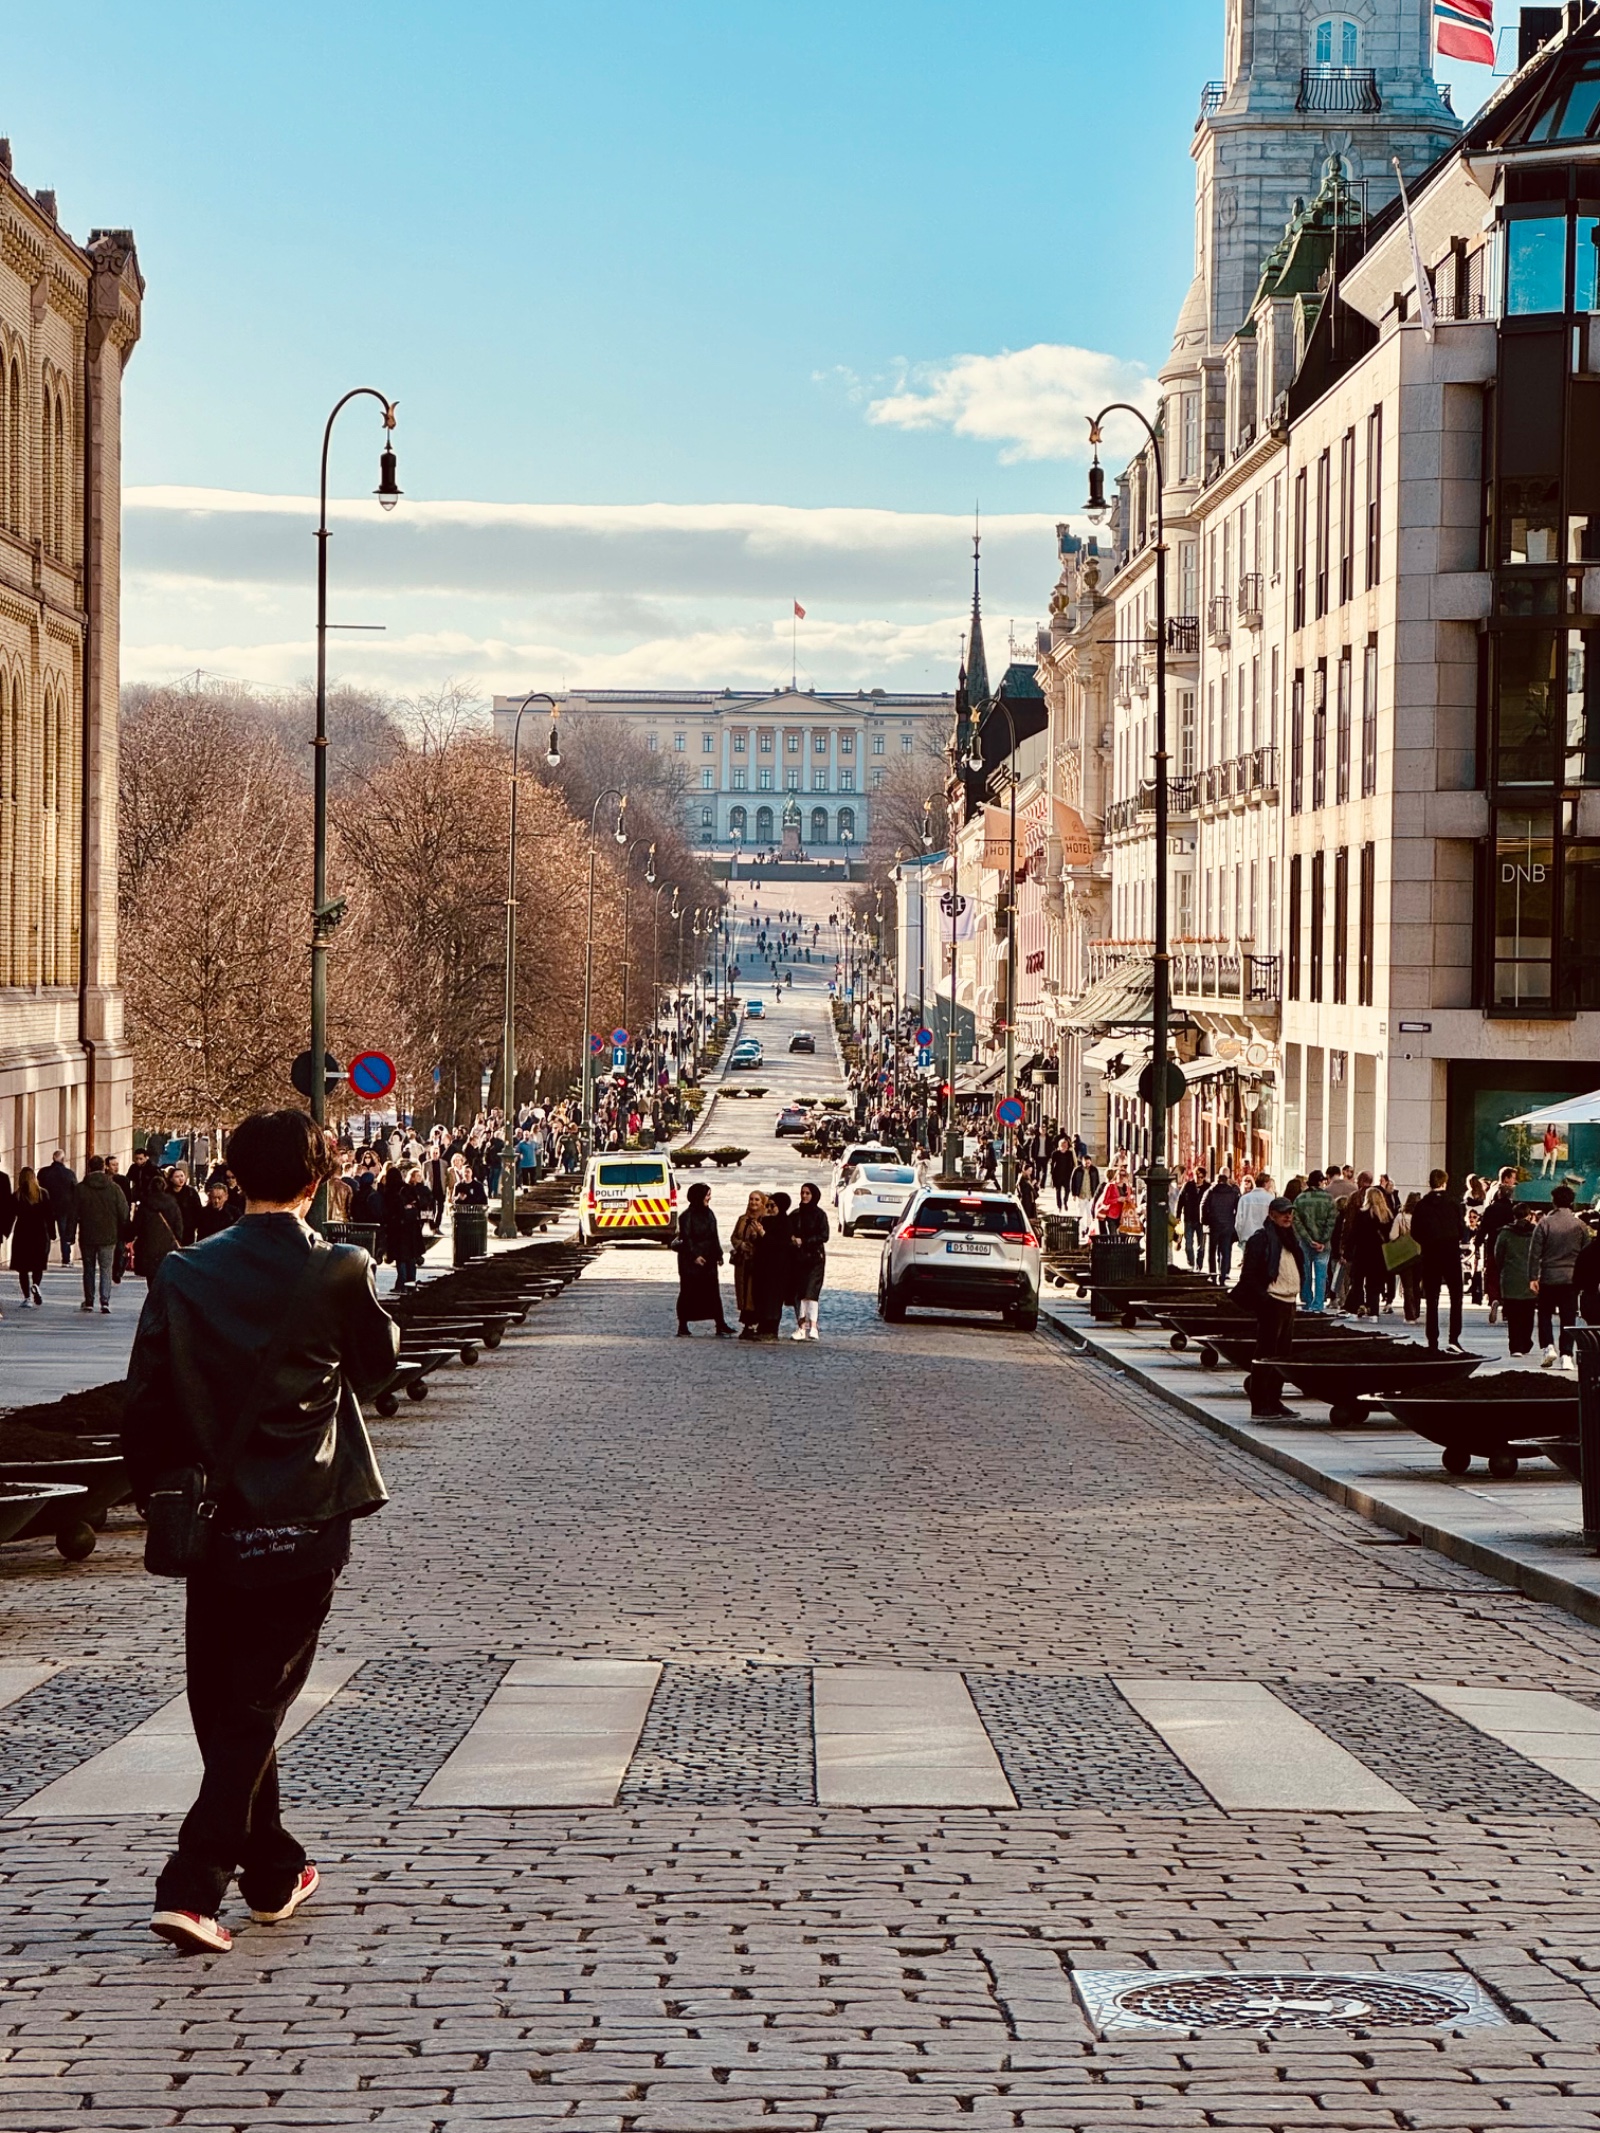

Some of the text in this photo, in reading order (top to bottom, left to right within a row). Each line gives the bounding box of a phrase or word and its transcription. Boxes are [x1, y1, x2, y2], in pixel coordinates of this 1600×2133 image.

[990, 846, 1023, 857] HOTL
[1066, 842, 1092, 855] HOTEL
[1502, 863, 1546, 883] DNB
[595, 1189, 623, 1197] POLITI
[953, 1243, 988, 1253] DS 10406
